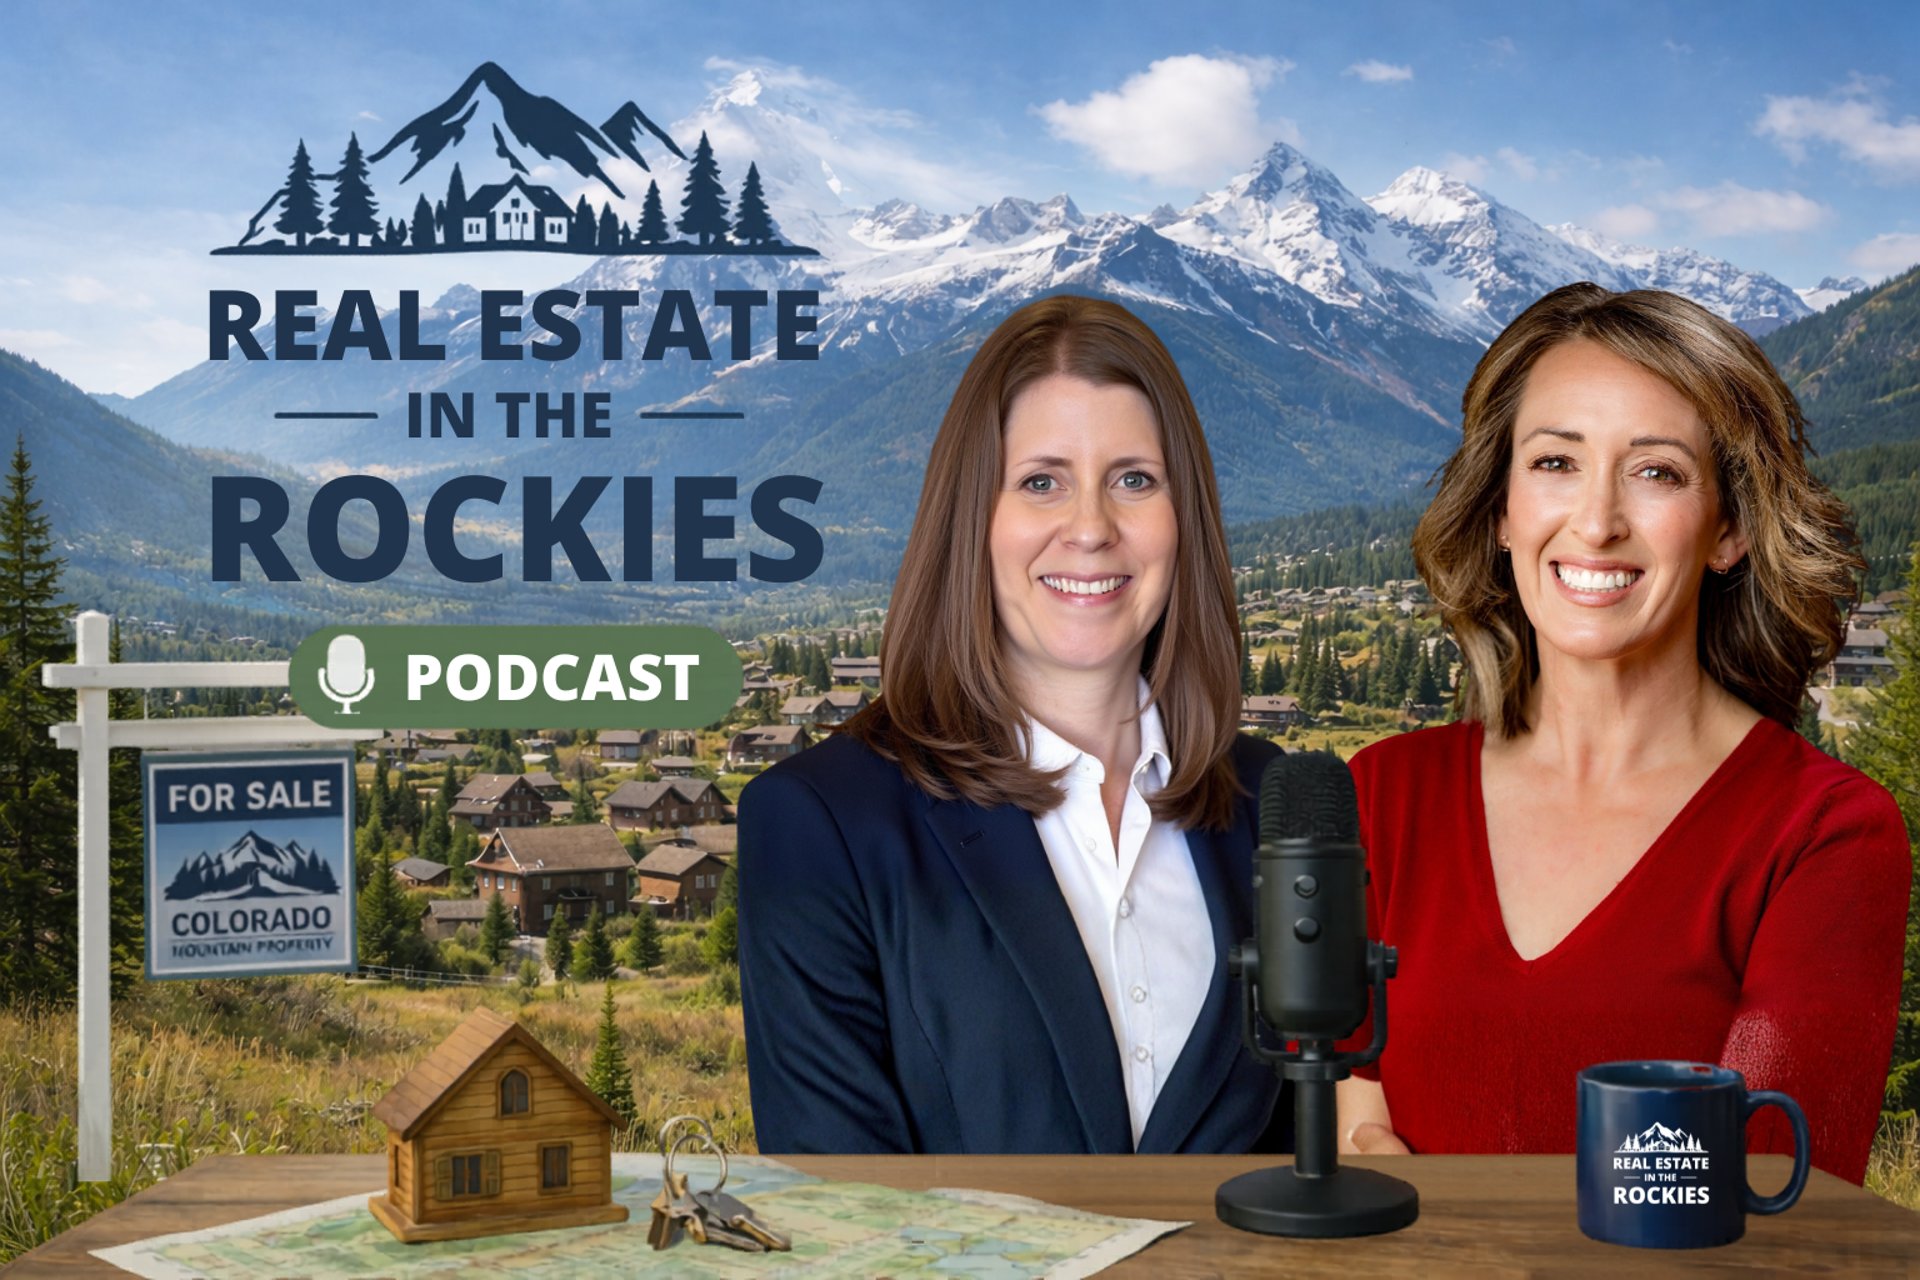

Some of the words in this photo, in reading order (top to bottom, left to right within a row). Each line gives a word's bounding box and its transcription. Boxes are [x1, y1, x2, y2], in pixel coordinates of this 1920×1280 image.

[168, 783, 235, 813] FOR
[246, 780, 332, 809] SALE
[172, 906, 331, 936] COLORADO
[1613, 1157, 1651, 1170] REAL
[1655, 1157, 1710, 1170] ESTATE
[1644, 1173, 1656, 1182] IN
[1659, 1173, 1677, 1182] THE
[1613, 1186, 1710, 1205] ROCKIES
